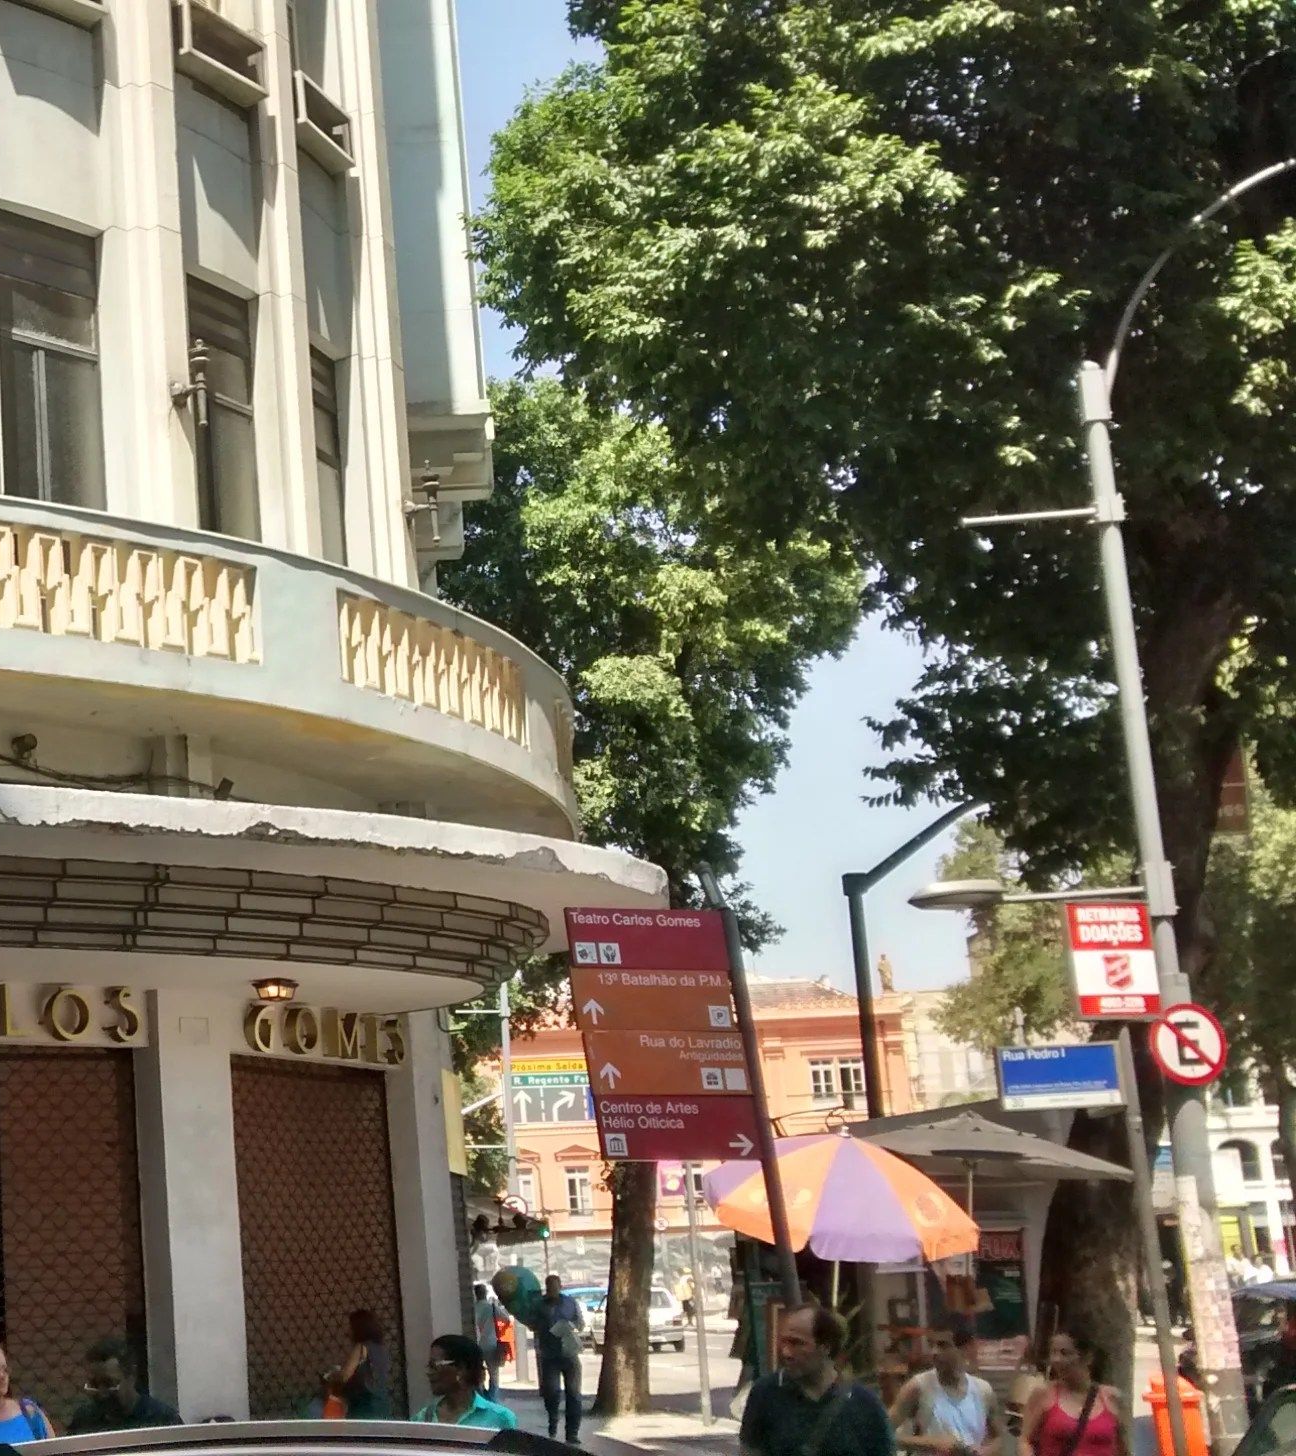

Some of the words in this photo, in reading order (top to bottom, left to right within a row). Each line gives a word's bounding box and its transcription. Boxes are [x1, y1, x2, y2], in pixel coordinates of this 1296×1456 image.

[570, 912, 609, 924] Teatro
[612, 913, 653, 926] Carlos
[656, 914, 701, 928] Gomes
[1078, 921, 1143, 945] DOAÇÕES
[621, 972, 677, 987] Batalhão
[680, 975, 696, 987] da
[244, 1003, 405, 1066] GOMES
[640, 1035, 665, 1047] Rua
[669, 1036, 685, 1048] do
[688, 1037, 742, 1050] Lavradio
[1003, 1050, 1025, 1061] Rua
[1027, 1048, 1059, 1060] Pedro
[528, 1075, 570, 1087] Regente
[600, 1101, 643, 1114] Centro
[646, 1102, 662, 1114] de
[666, 1102, 699, 1115] Artes
[601, 1115, 635, 1129] Hélio
[637, 1116, 685, 1129] Oiticica
